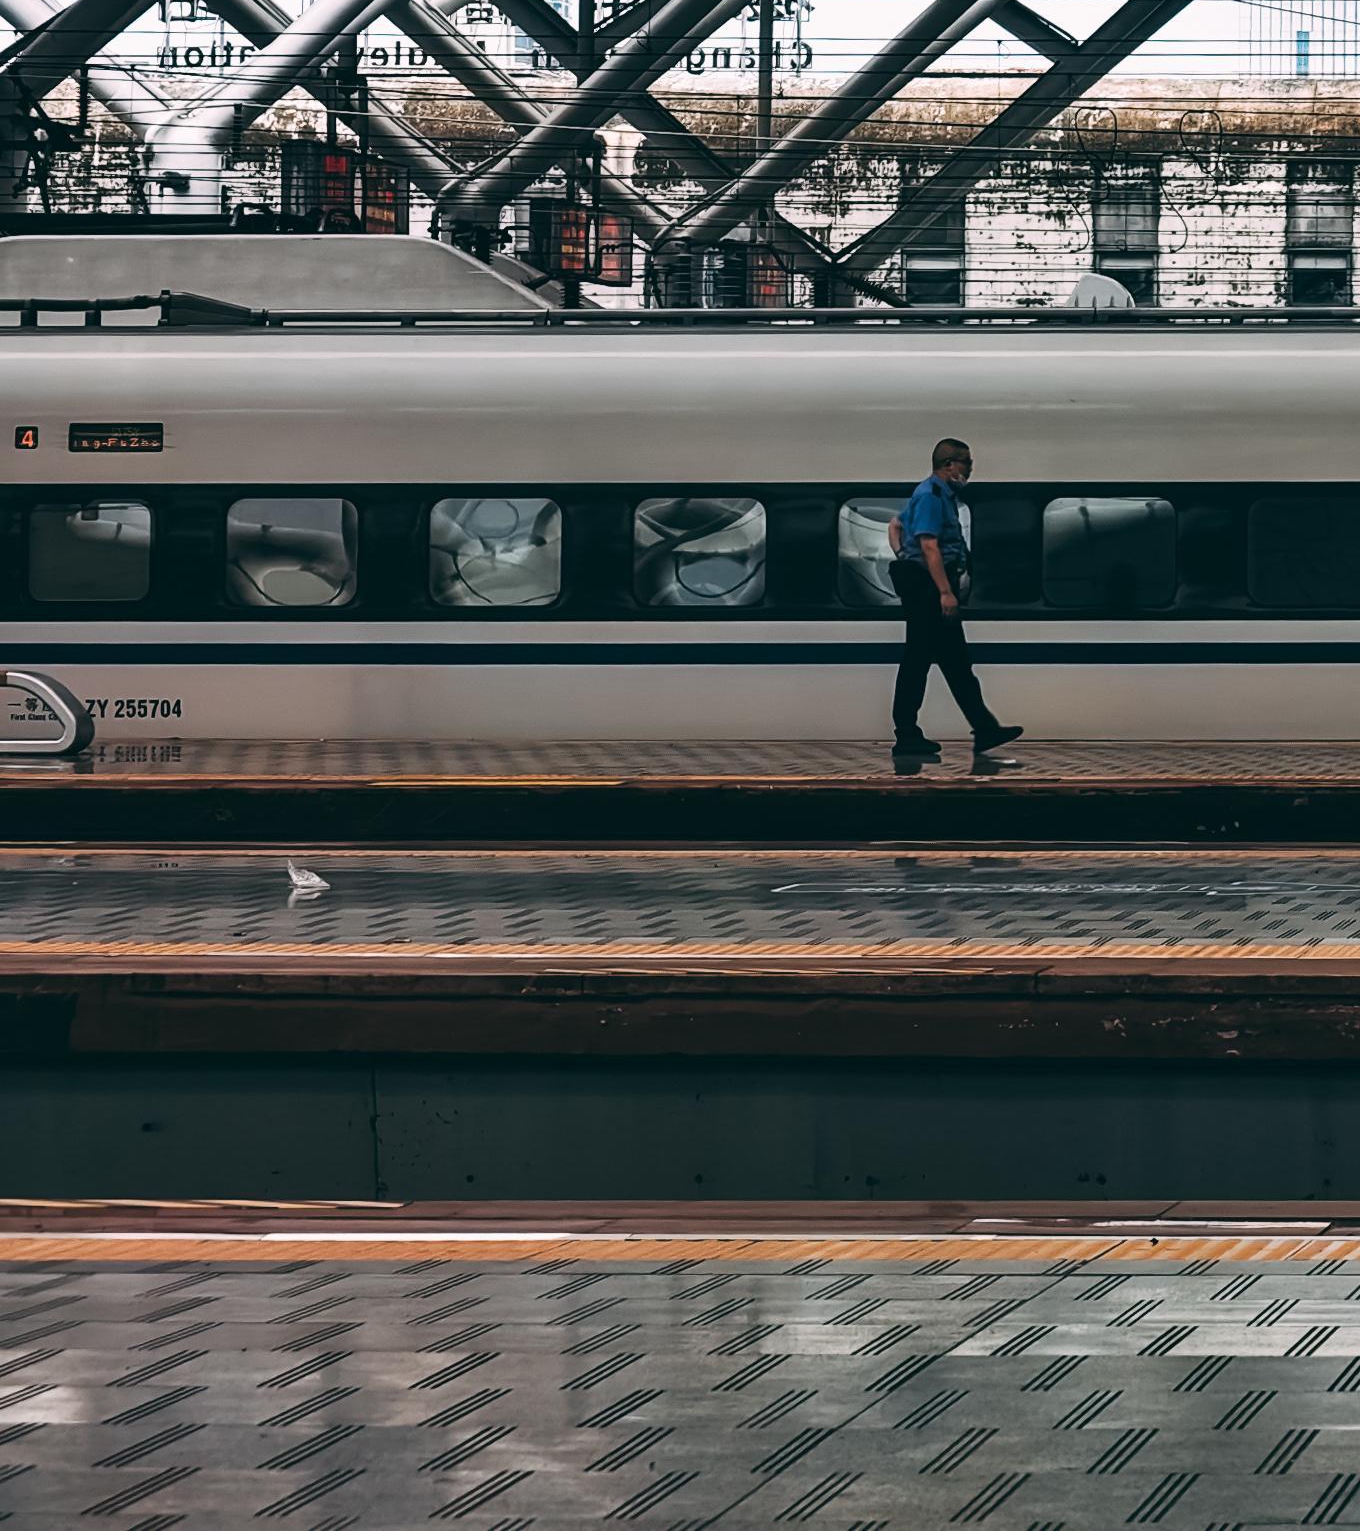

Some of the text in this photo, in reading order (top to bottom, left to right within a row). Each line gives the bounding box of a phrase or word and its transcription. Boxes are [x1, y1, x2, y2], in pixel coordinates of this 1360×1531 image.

[21, 430, 34, 447] 4
[85, 699, 182, 718] ZY 255704
